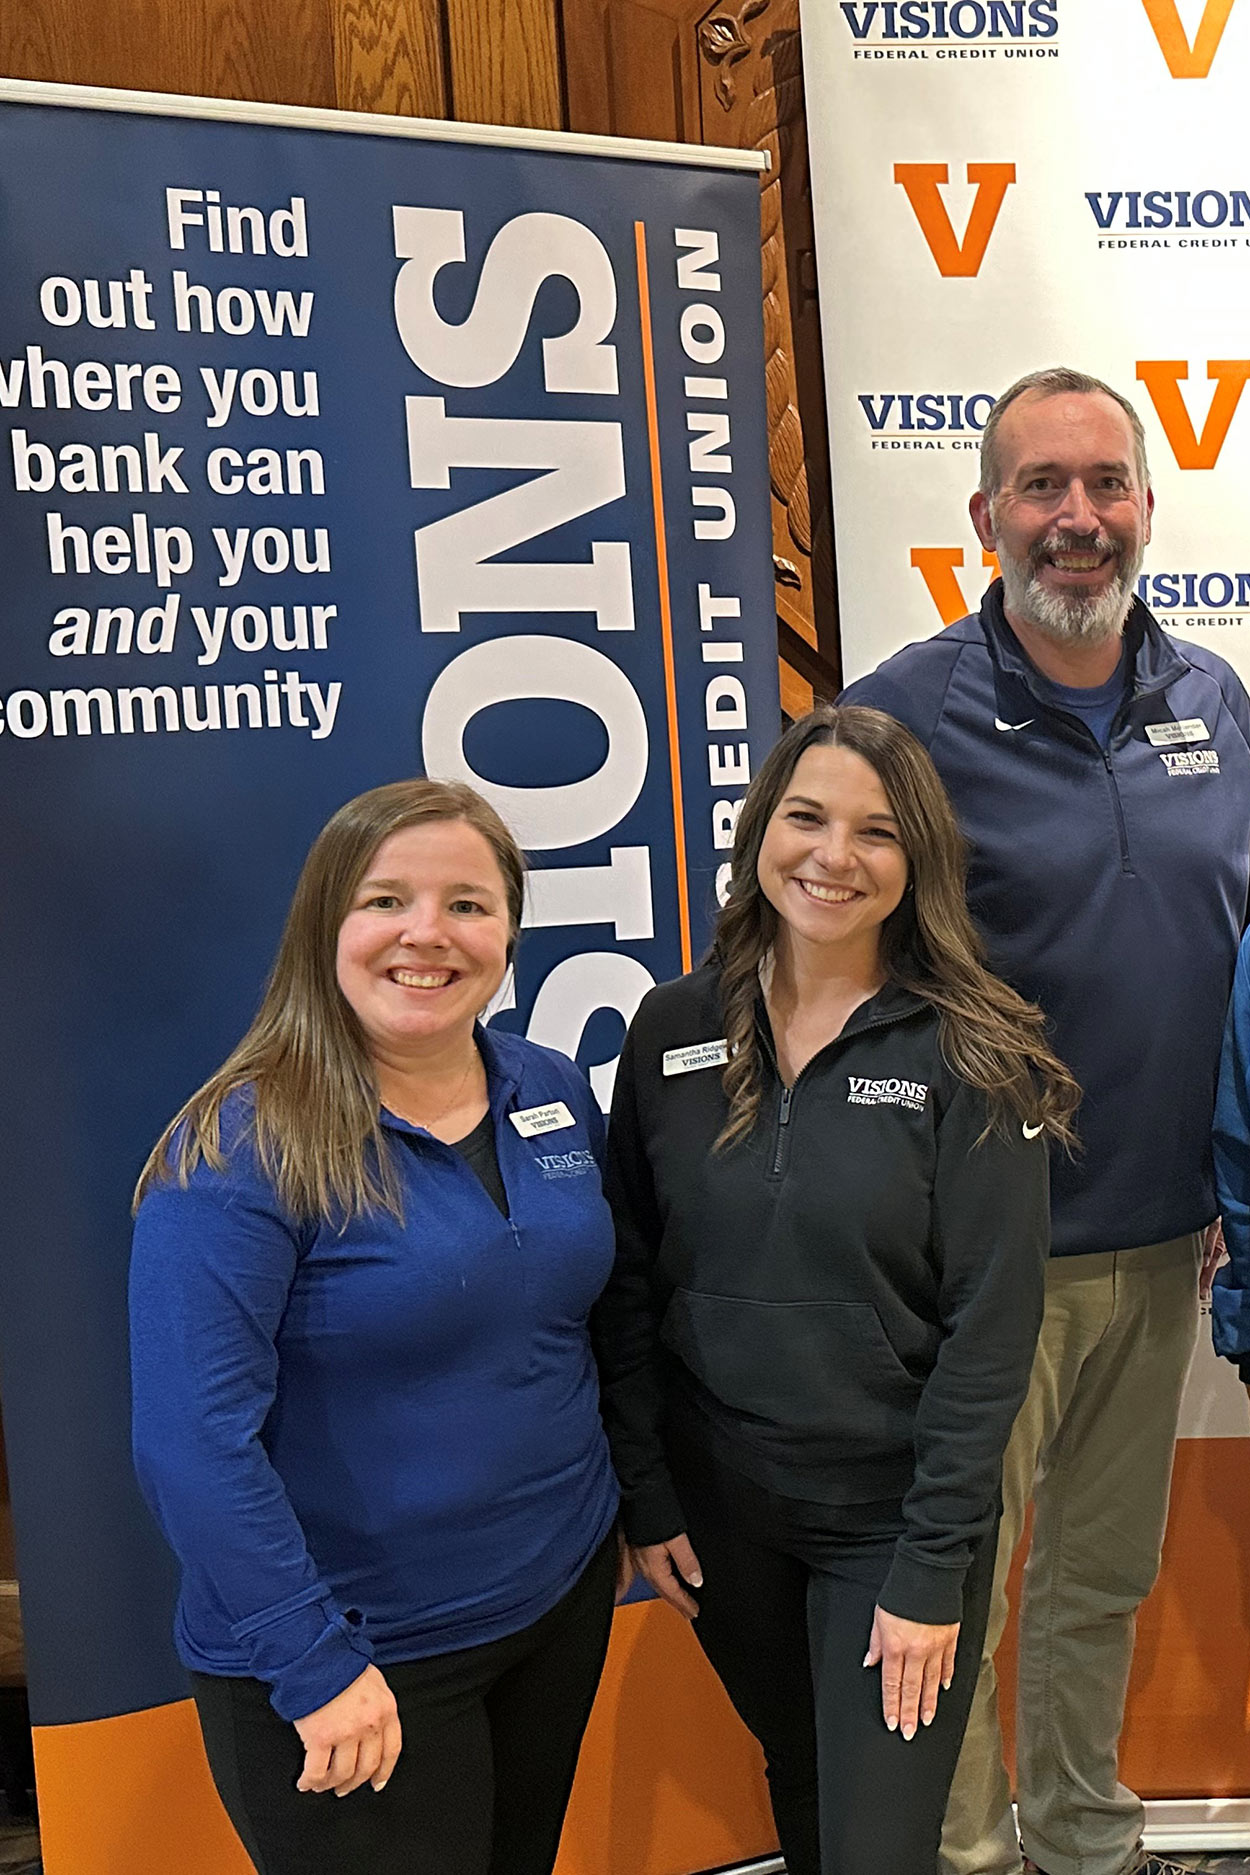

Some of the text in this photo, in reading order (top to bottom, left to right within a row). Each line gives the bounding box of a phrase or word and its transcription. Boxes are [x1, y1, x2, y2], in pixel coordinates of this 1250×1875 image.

[840, 0, 1059, 39] VISIONS
[853, 47, 1060, 60] FEDERAL CREDIT UNION
[1141, 0, 1235, 79] V
[166, 187, 309, 258] Find
[893, 162, 1017, 278] V
[1098, 239, 1171, 249] FEDERAL
[1178, 238, 1239, 249] CREDIT
[40, 269, 314, 337] out how
[199, 367, 320, 427] you
[674, 227, 736, 540] UNION
[857, 393, 996, 431] VISIO
[11, 429, 325, 495] bank can
[871, 441, 945, 450] FEDERAL
[46, 512, 331, 587] help you
[48, 593, 338, 666] and your
[1185, 617, 1243, 627] CREDIT
[0, 669, 342, 740] ommunity
[1159, 750, 1219, 767] VISIONS
[665, 1049, 701, 1061] Samantha
[682, 1053, 721, 1066] VISIONS
[848, 1076, 928, 1100] VISIONS
[520, 1112, 539, 1123] Sarah
[530, 1117, 559, 1129] VISIONS
